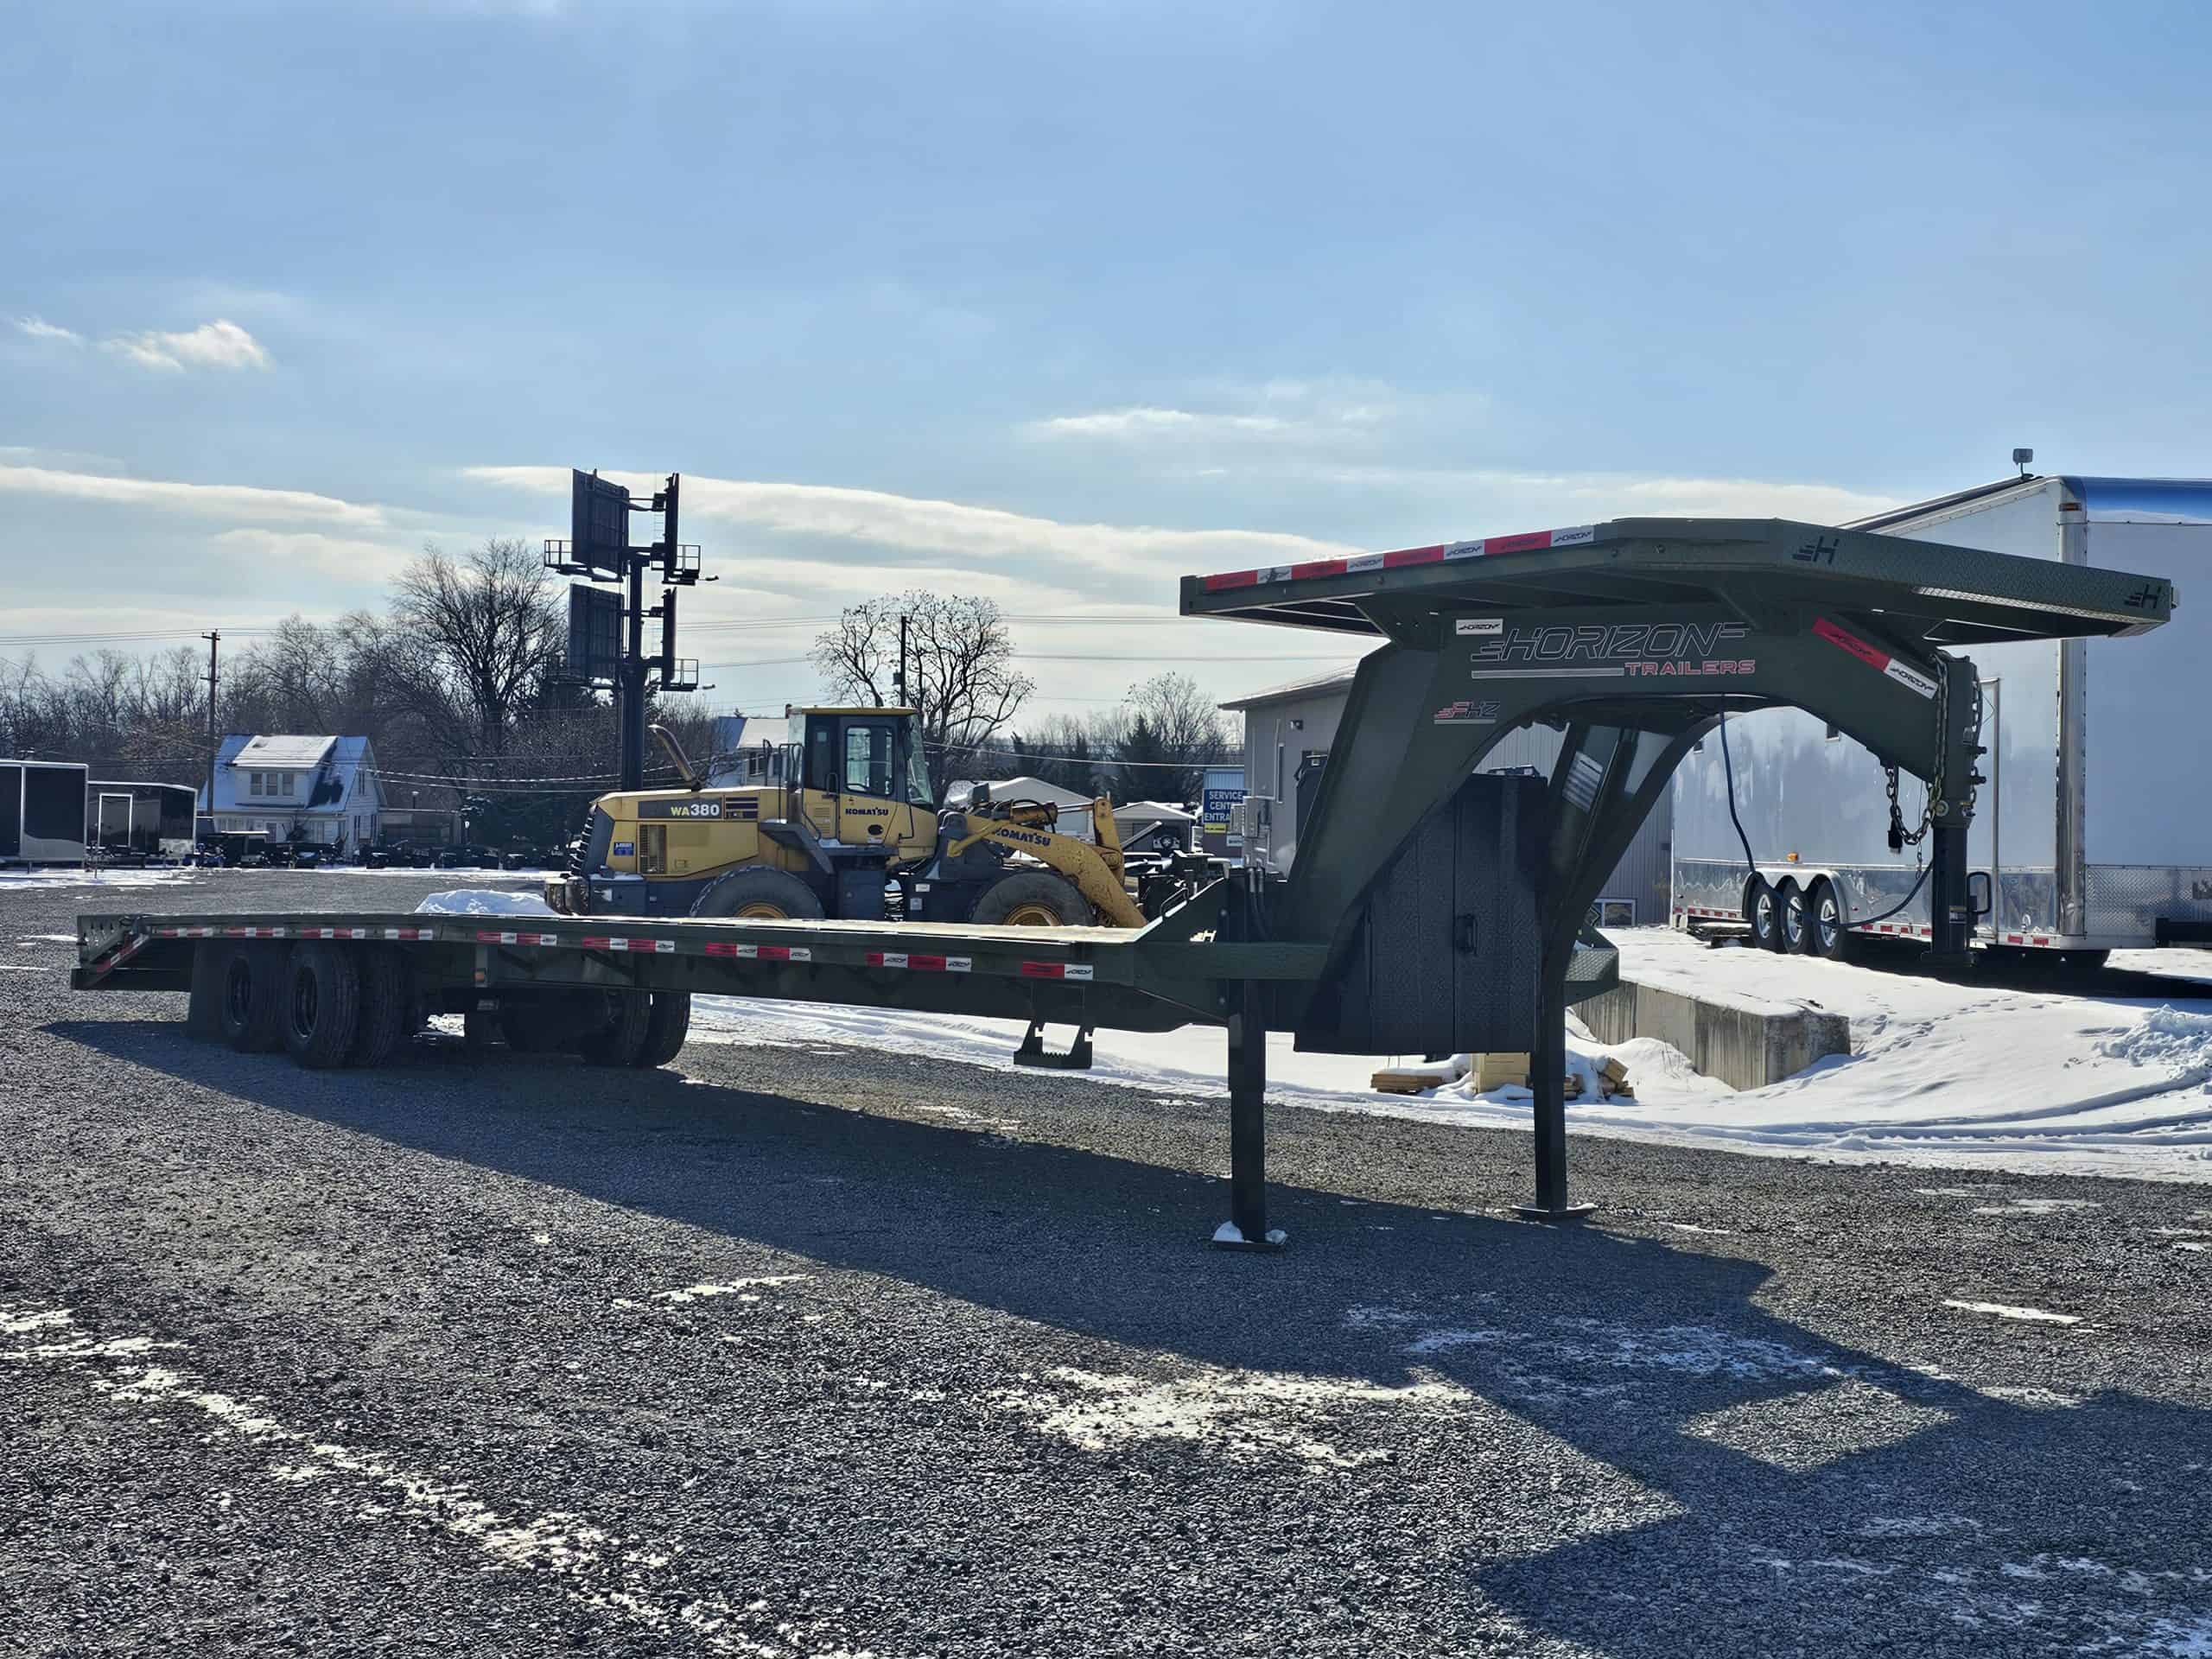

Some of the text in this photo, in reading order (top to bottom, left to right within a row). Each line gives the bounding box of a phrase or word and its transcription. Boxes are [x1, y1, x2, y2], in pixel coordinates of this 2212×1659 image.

[1471, 622, 1751, 662] HORIZON
[1624, 659, 1756, 677] TRAILERS
[1209, 791, 1243, 800] SERVICE
[1210, 801, 1231, 810] CENT
[671, 804, 721, 817] WA380
[845, 807, 889, 816] KOMATSU
[1205, 812, 1231, 821] ENTRA
